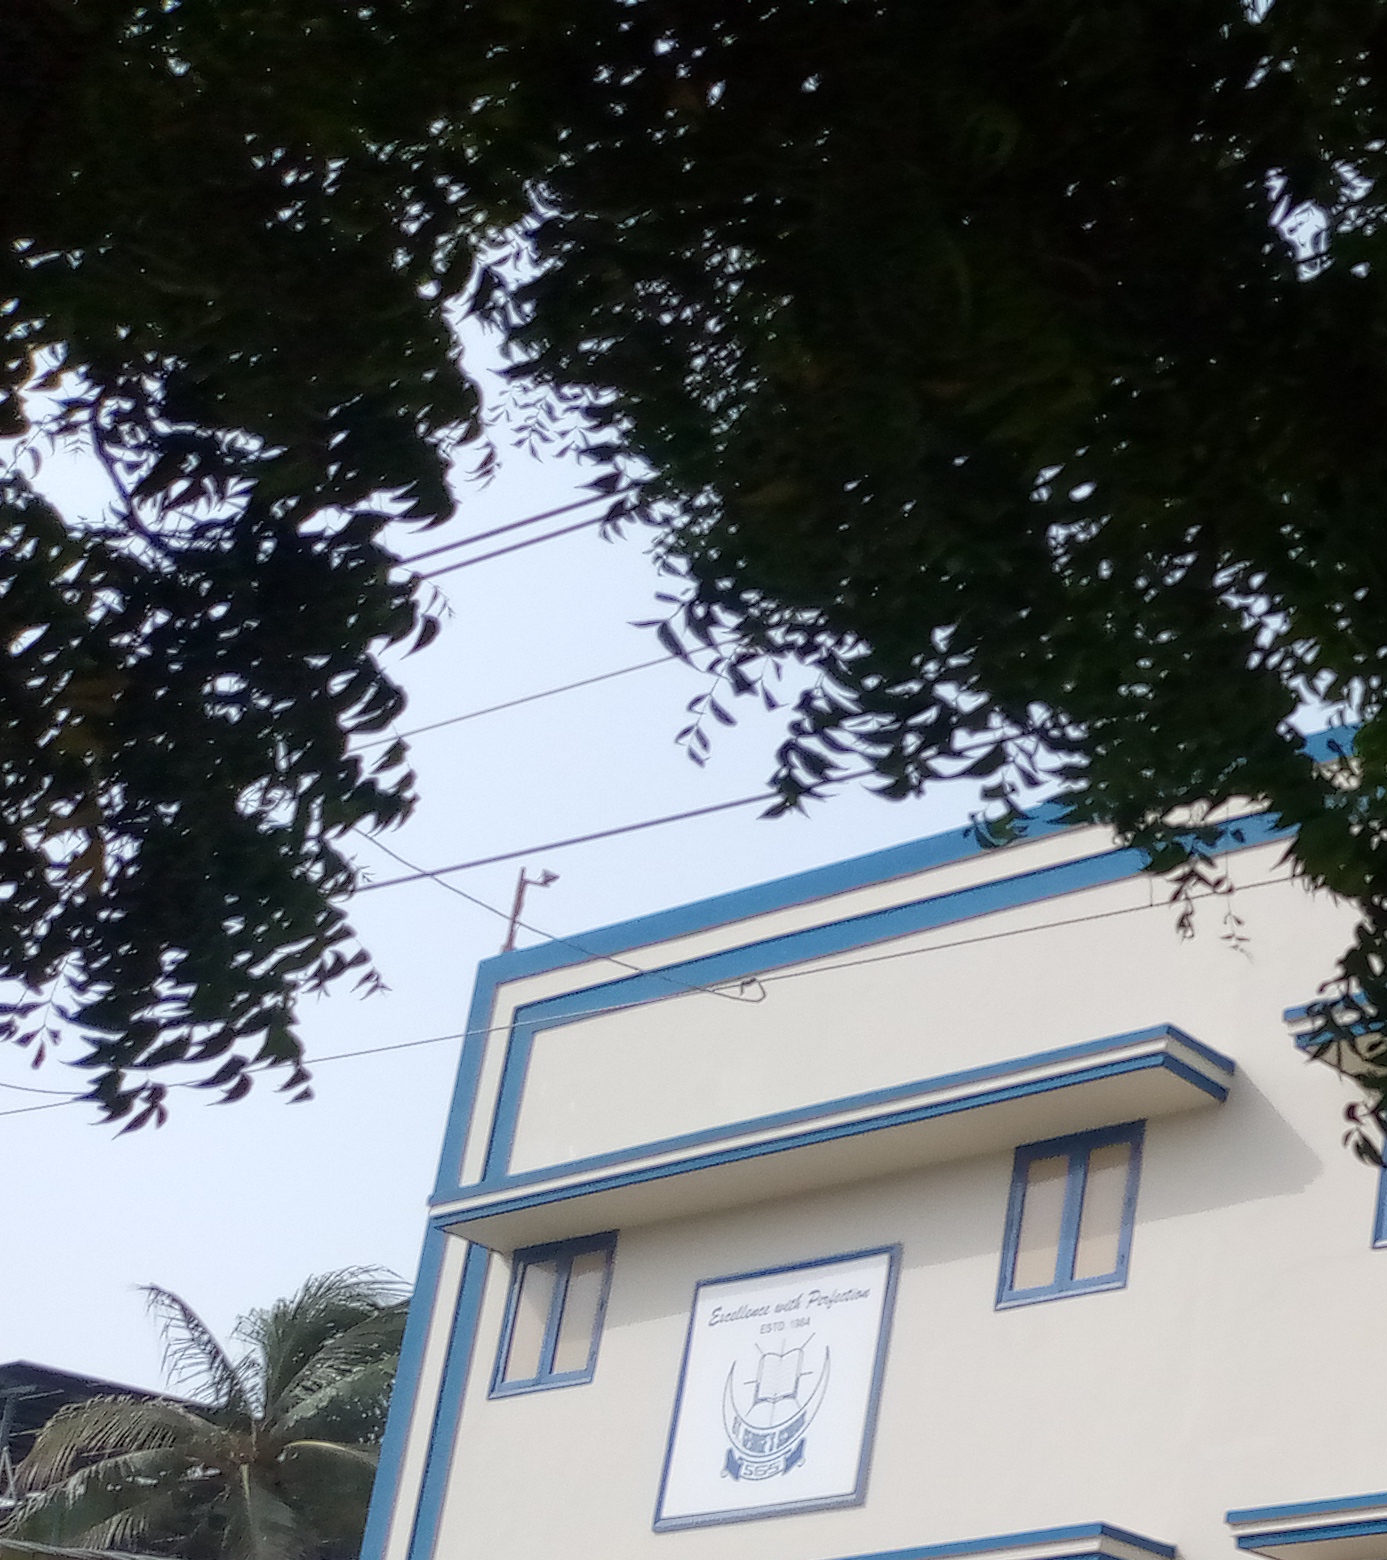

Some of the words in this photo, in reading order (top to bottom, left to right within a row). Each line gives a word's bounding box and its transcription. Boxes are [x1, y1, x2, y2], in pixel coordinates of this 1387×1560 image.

[708, 1305, 770, 1327] Excellence
[773, 1293, 803, 1314] with
[806, 1289, 871, 1310] Perfection
